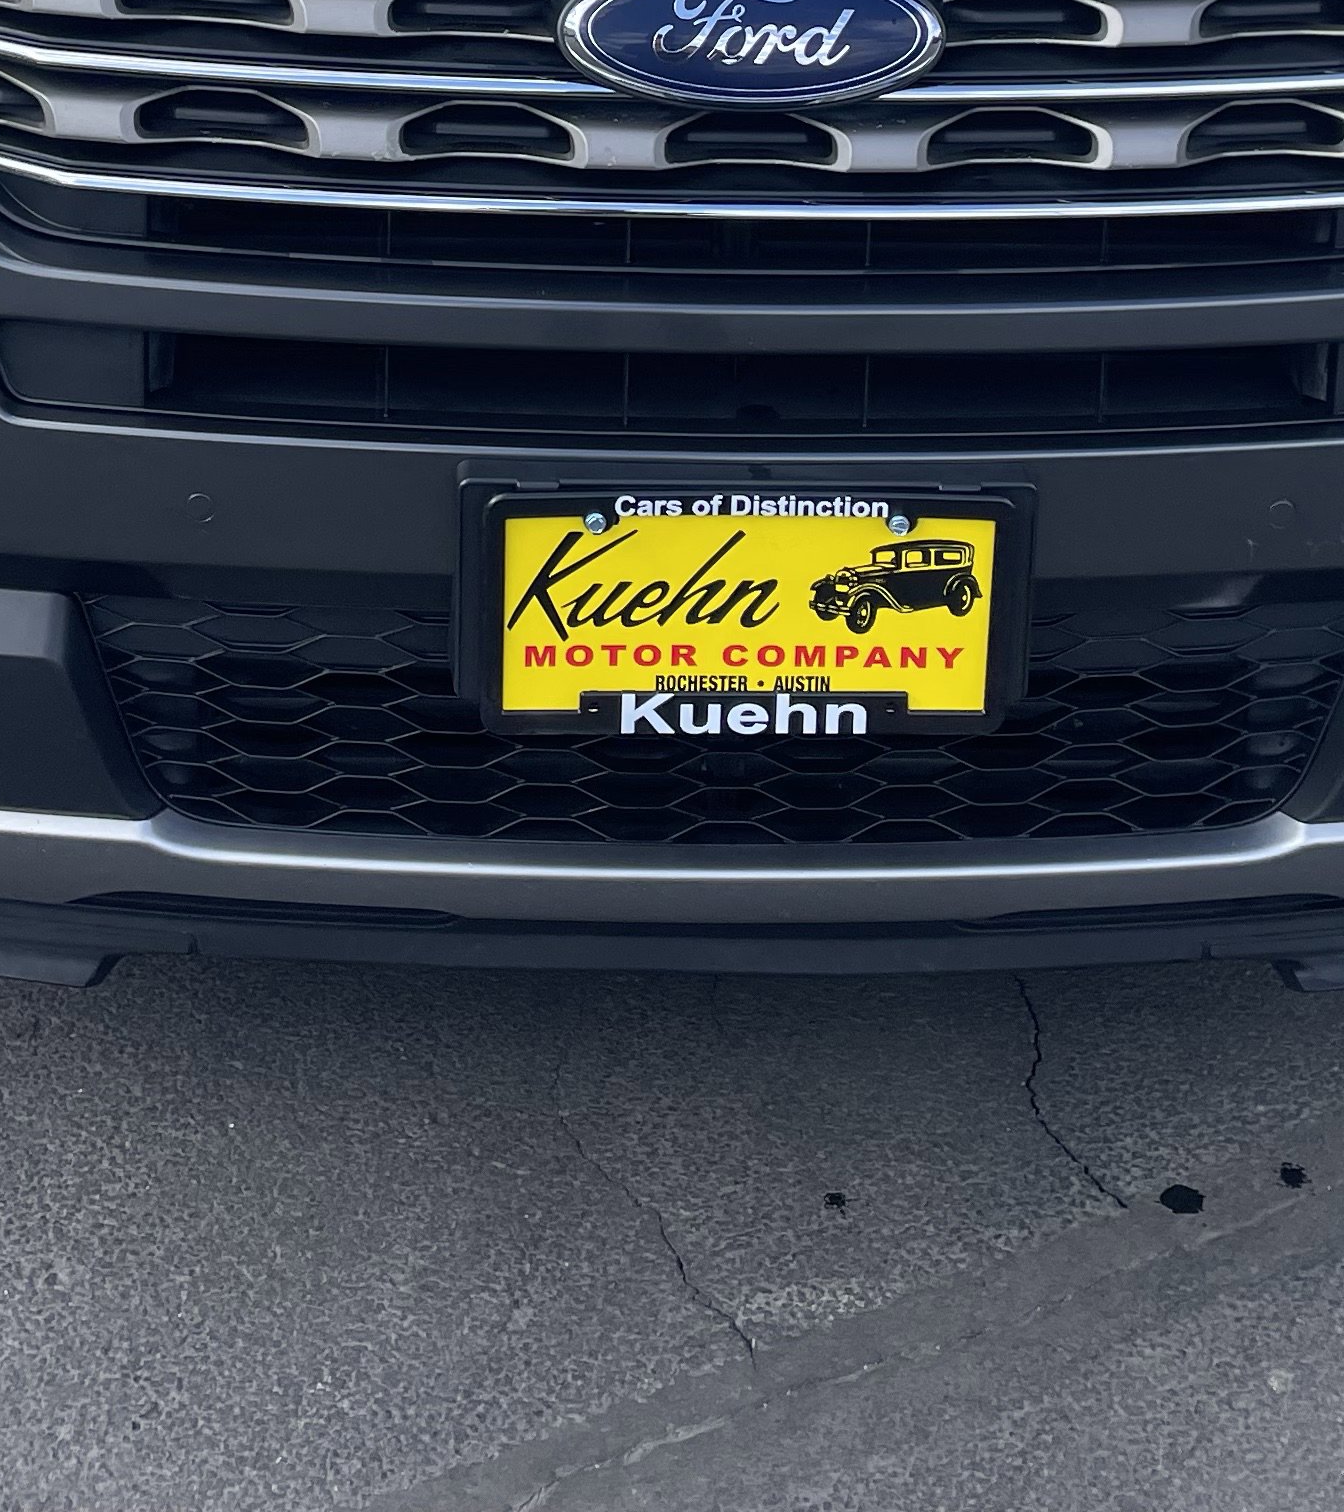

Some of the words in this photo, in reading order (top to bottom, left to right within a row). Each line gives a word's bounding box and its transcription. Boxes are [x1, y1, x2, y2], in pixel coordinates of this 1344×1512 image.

[614, 495, 683, 517] Cars
[692, 494, 723, 517] of
[730, 495, 890, 518] Distinction
[506, 529, 780, 642] Kuehn
[524, 644, 698, 667] MOTOR
[722, 644, 965, 669] COMPANY
[655, 675, 748, 692] ROCHESTER
[773, 676, 831, 692] AUSTIN
[619, 692, 868, 735] Kuehn
